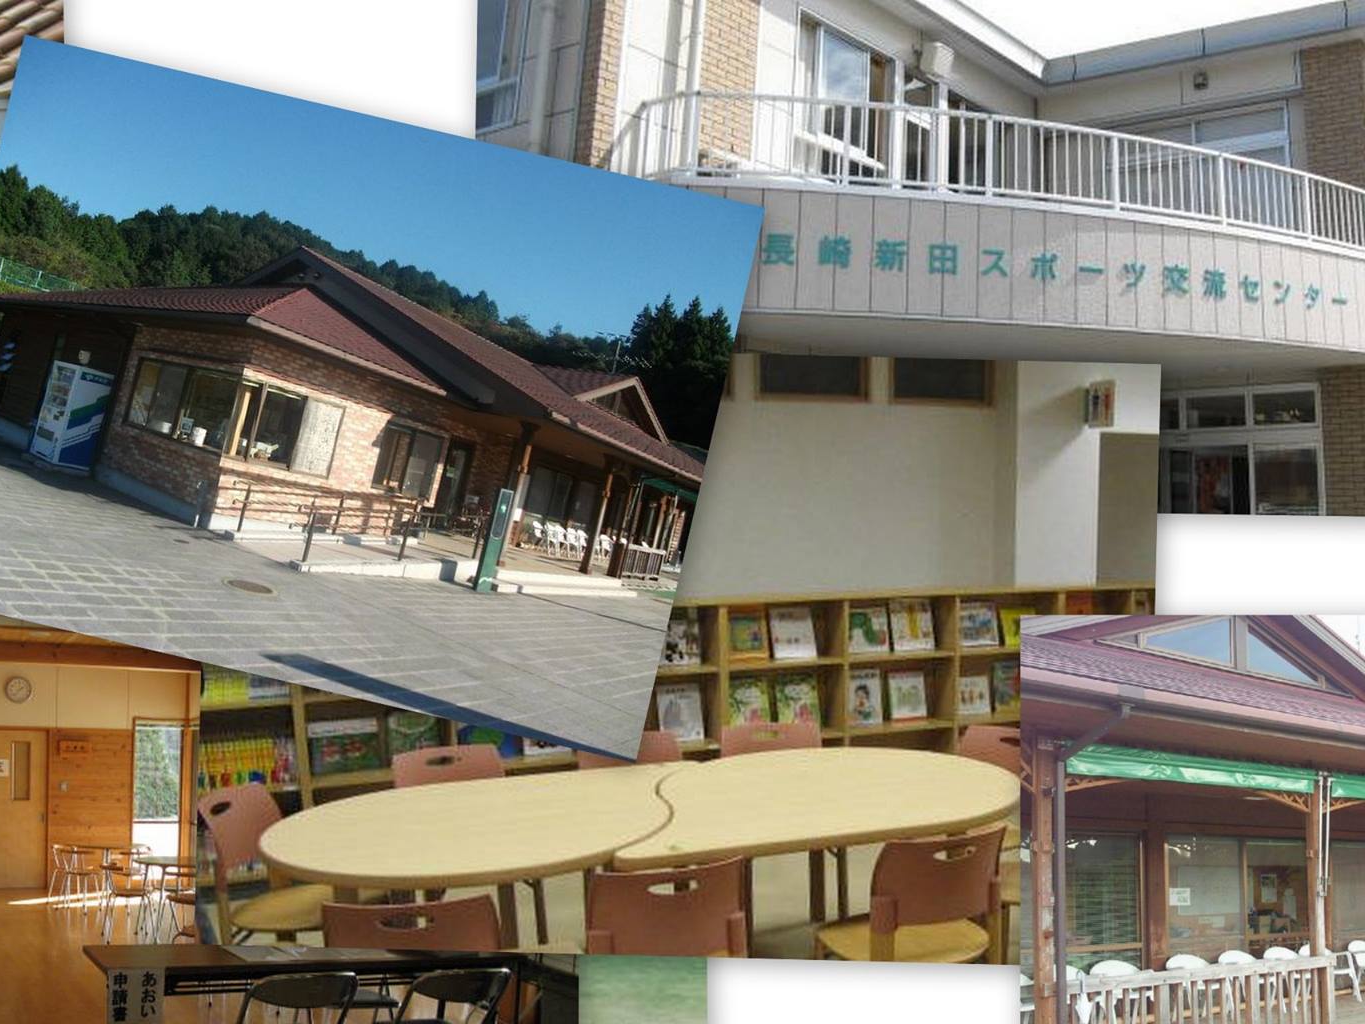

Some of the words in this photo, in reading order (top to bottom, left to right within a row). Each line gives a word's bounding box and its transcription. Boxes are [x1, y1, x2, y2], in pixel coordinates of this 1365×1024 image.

[763, 233, 1348, 309] 長崎新田スポーツ交流センター
[112, 972, 128, 1022] 申請書
[140, 971, 157, 1018] あおい
